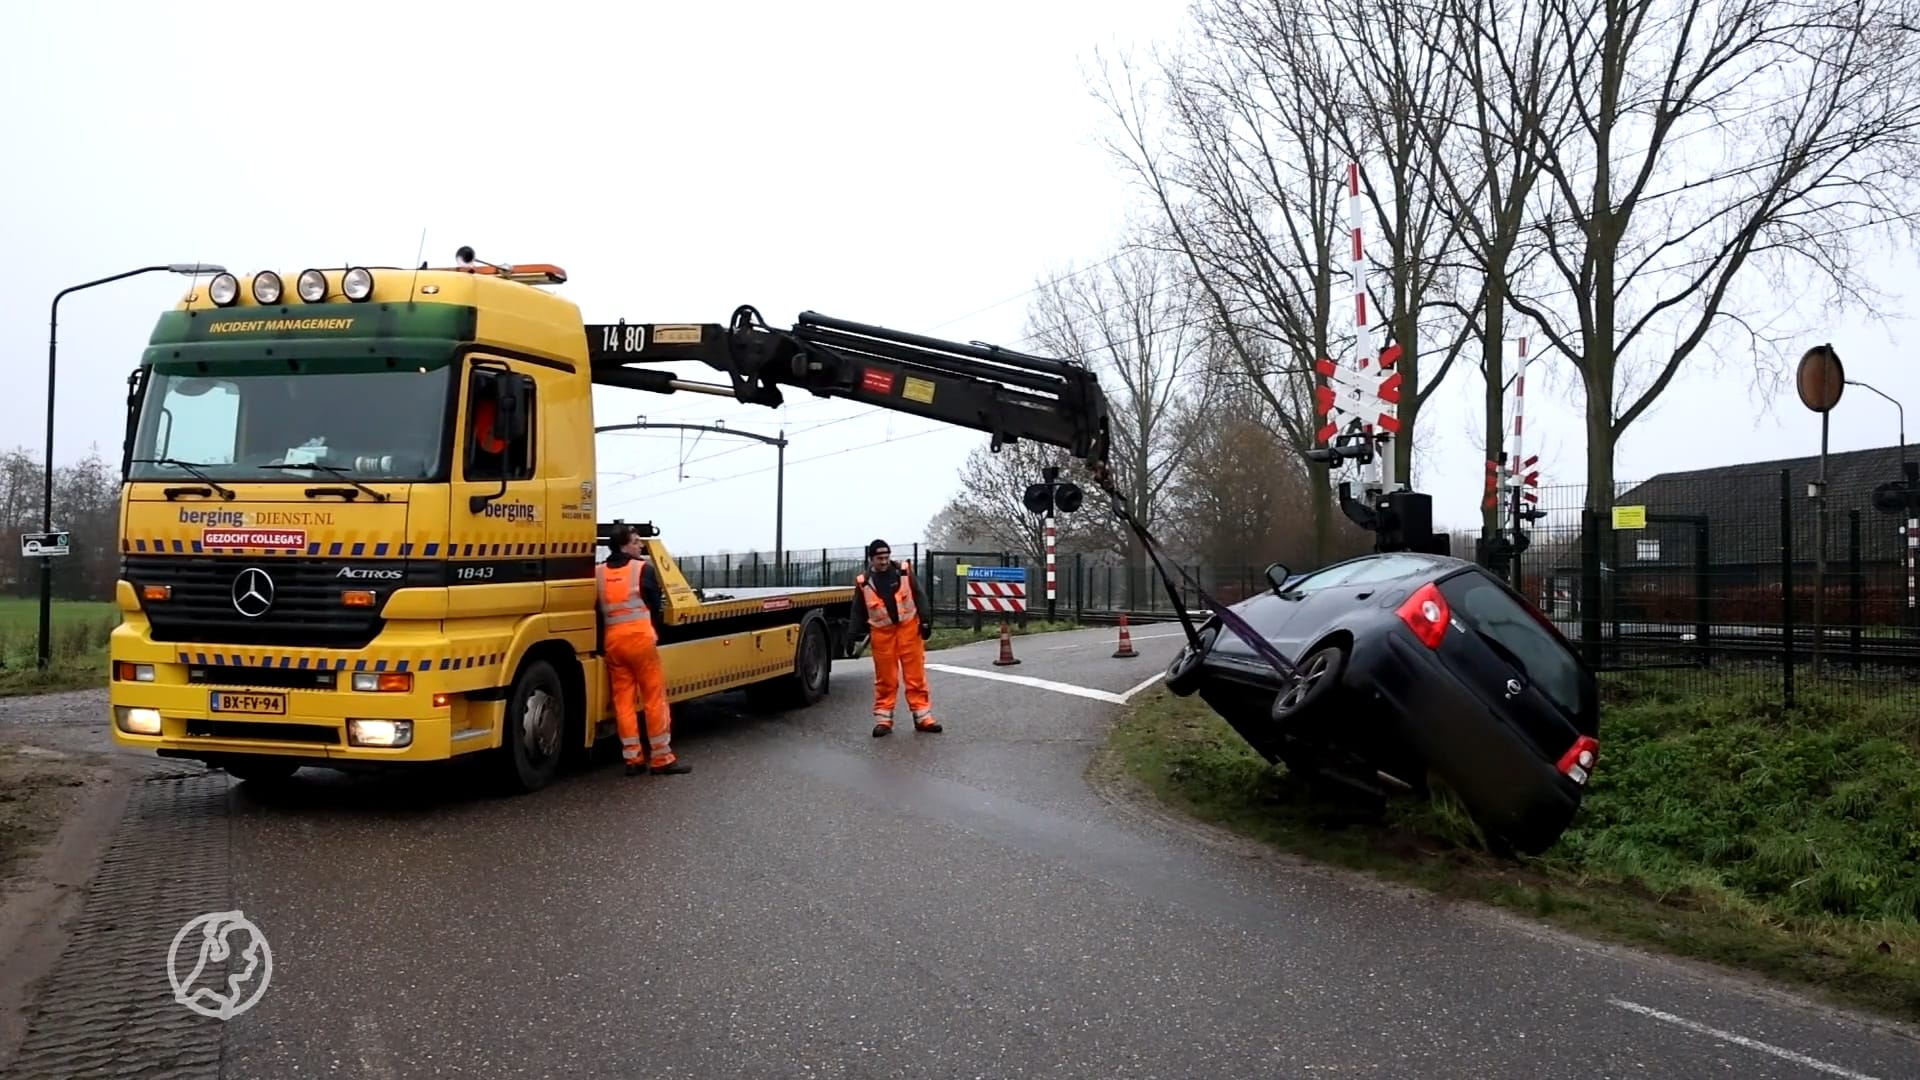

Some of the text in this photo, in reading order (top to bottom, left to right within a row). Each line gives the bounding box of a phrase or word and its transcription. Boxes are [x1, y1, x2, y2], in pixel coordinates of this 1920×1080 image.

[209, 318, 354, 333] INCIDENT MANAGEMENT
[603, 326, 619, 352] 14
[624, 326, 645, 352] 80
[206, 533, 303, 545] GEZOCHT COLLEGA'S
[456, 567, 494, 578] 1843
[968, 569, 994, 578] WACHT
[223, 696, 279, 710] BX-FV-94
